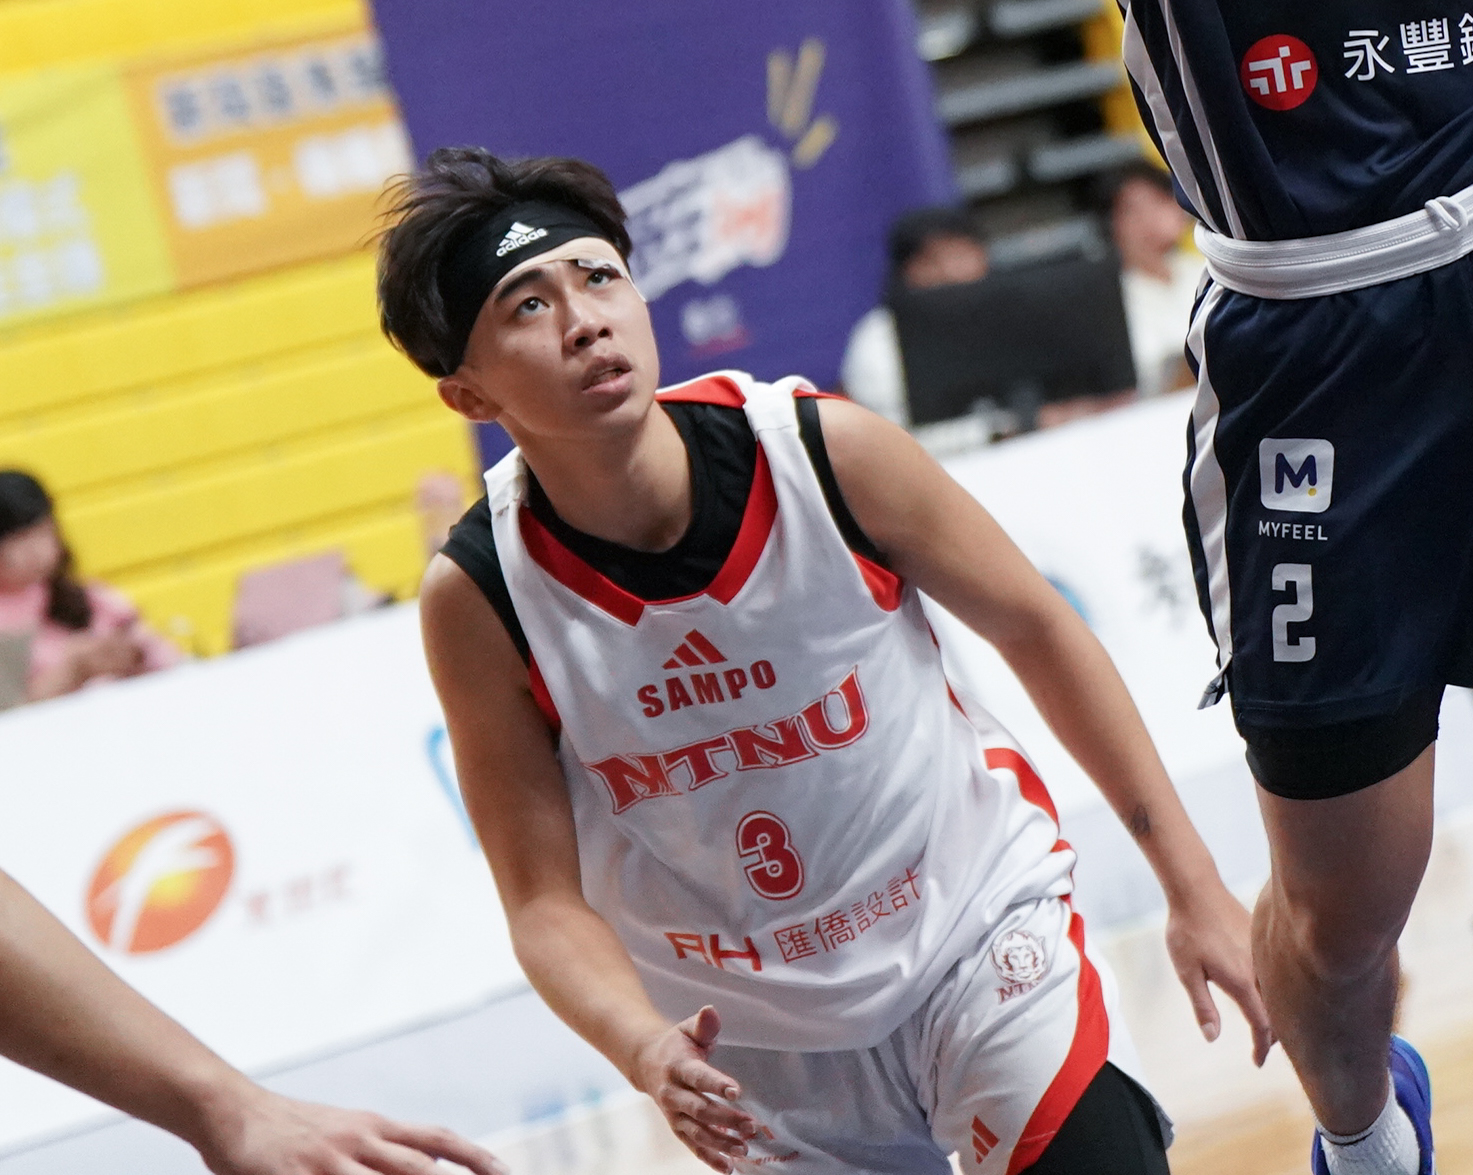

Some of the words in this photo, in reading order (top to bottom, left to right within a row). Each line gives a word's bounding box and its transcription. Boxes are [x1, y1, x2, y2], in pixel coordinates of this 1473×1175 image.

[496, 228, 548, 257] adidas
[1258, 520, 1329, 541] MYFEEL
[1272, 562, 1316, 663] 2
[637, 660, 777, 718] SAMPO
[583, 664, 870, 815] NTNU
[735, 810, 804, 901] 3
[773, 867, 922, 965] 匯僑設計
